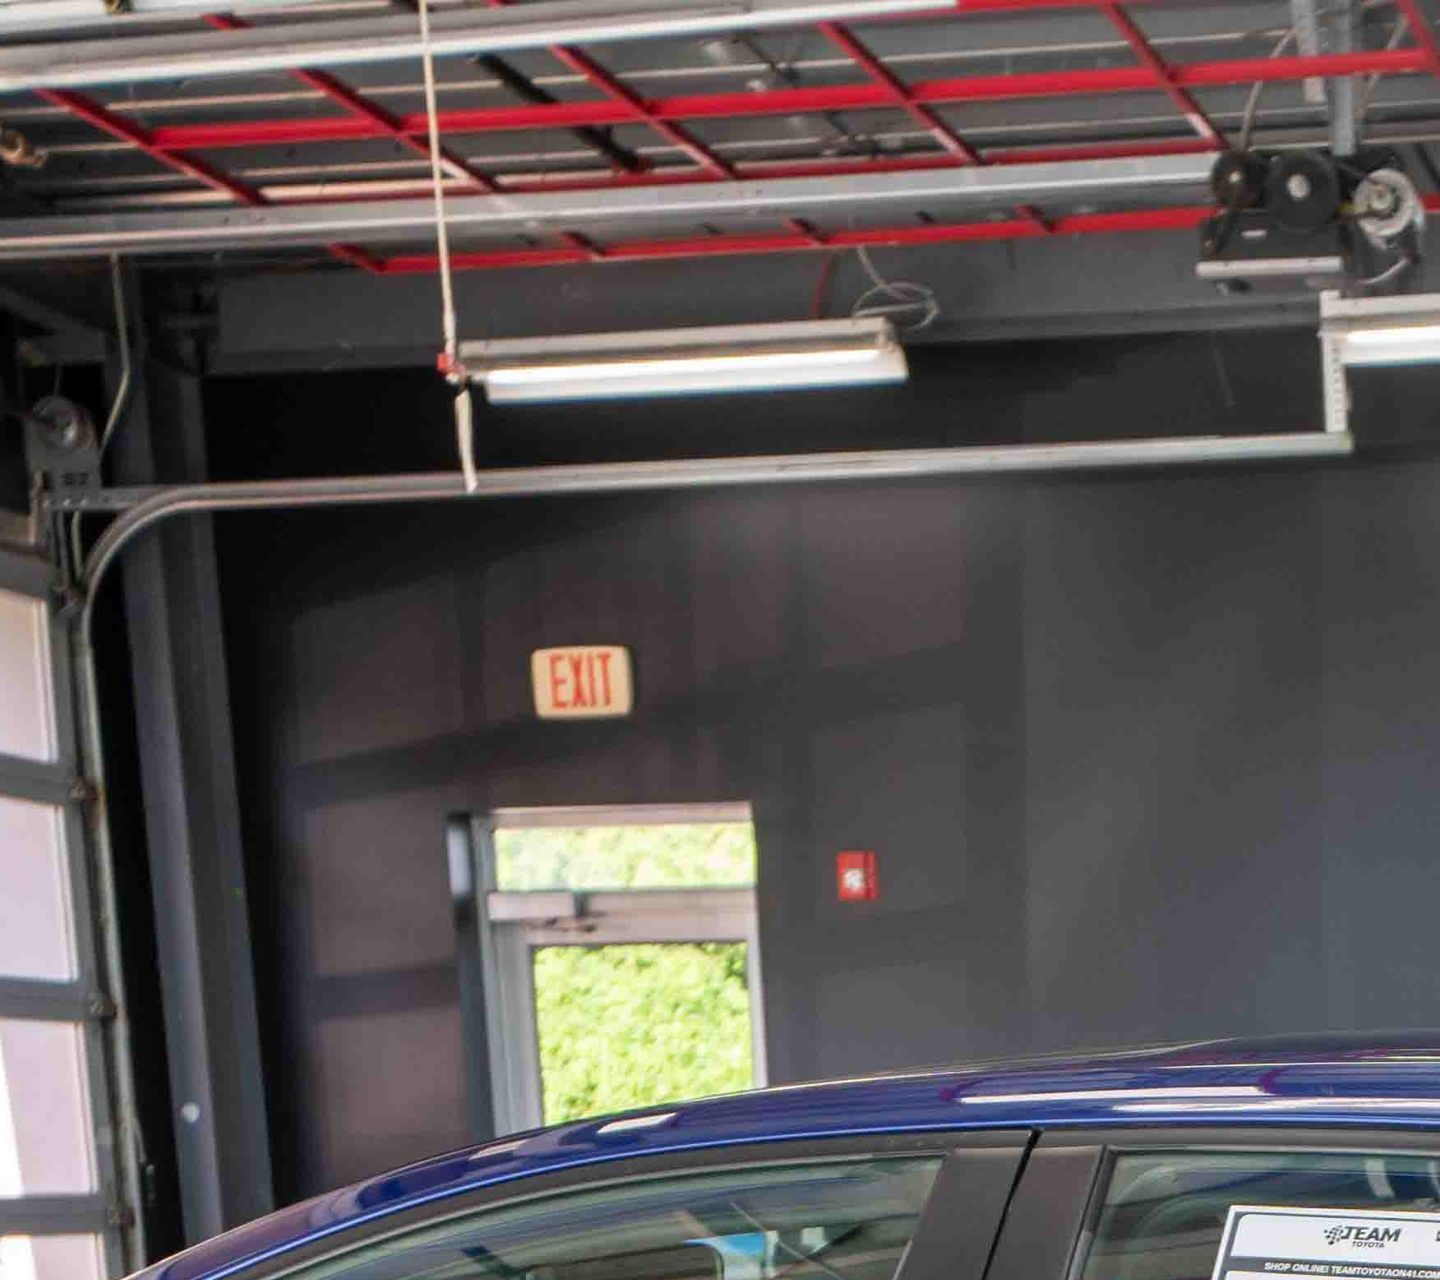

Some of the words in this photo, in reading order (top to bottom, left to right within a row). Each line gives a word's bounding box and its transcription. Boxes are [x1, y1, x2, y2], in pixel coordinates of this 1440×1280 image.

[549, 652, 613, 709] EXIT
[1342, 1226, 1402, 1242] TEAM
[1352, 1240, 1385, 1248] TOYOTA
[1264, 1262, 1291, 1272] SHOP
